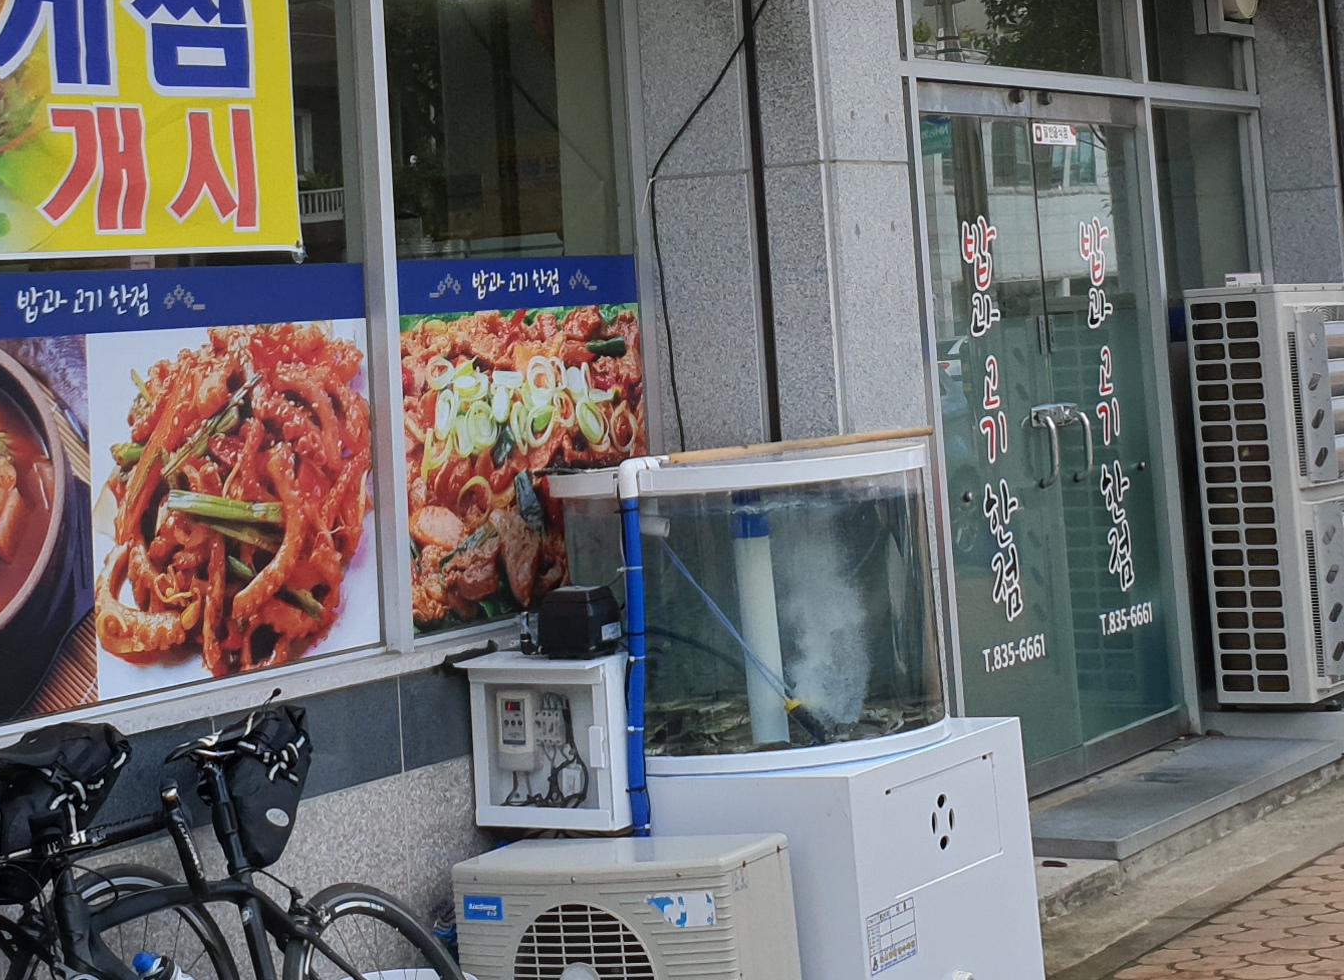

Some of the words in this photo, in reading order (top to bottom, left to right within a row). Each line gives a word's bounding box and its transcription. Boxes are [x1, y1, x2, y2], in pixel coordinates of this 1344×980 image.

[39, 103, 260, 234] 개시
[17, 286, 69, 324] 밥과
[72, 288, 103, 314] 고기
[109, 282, 150, 317] 한점
[471, 269, 506, 300] 밥과
[508, 271, 529, 292] 고기
[532, 267, 561, 296] 한점
[961, 215, 1002, 338] 밥과
[1079, 216, 1114, 329] 밥과
[979, 355, 1008, 464] 고기
[1096, 345, 1121, 446] 고기
[983, 478, 1024, 622] 한점
[1100, 460, 1135, 592] 한점
[982, 633, 1046, 673] T.835-6661
[1099, 601, 1154, 636] T.835-6661
